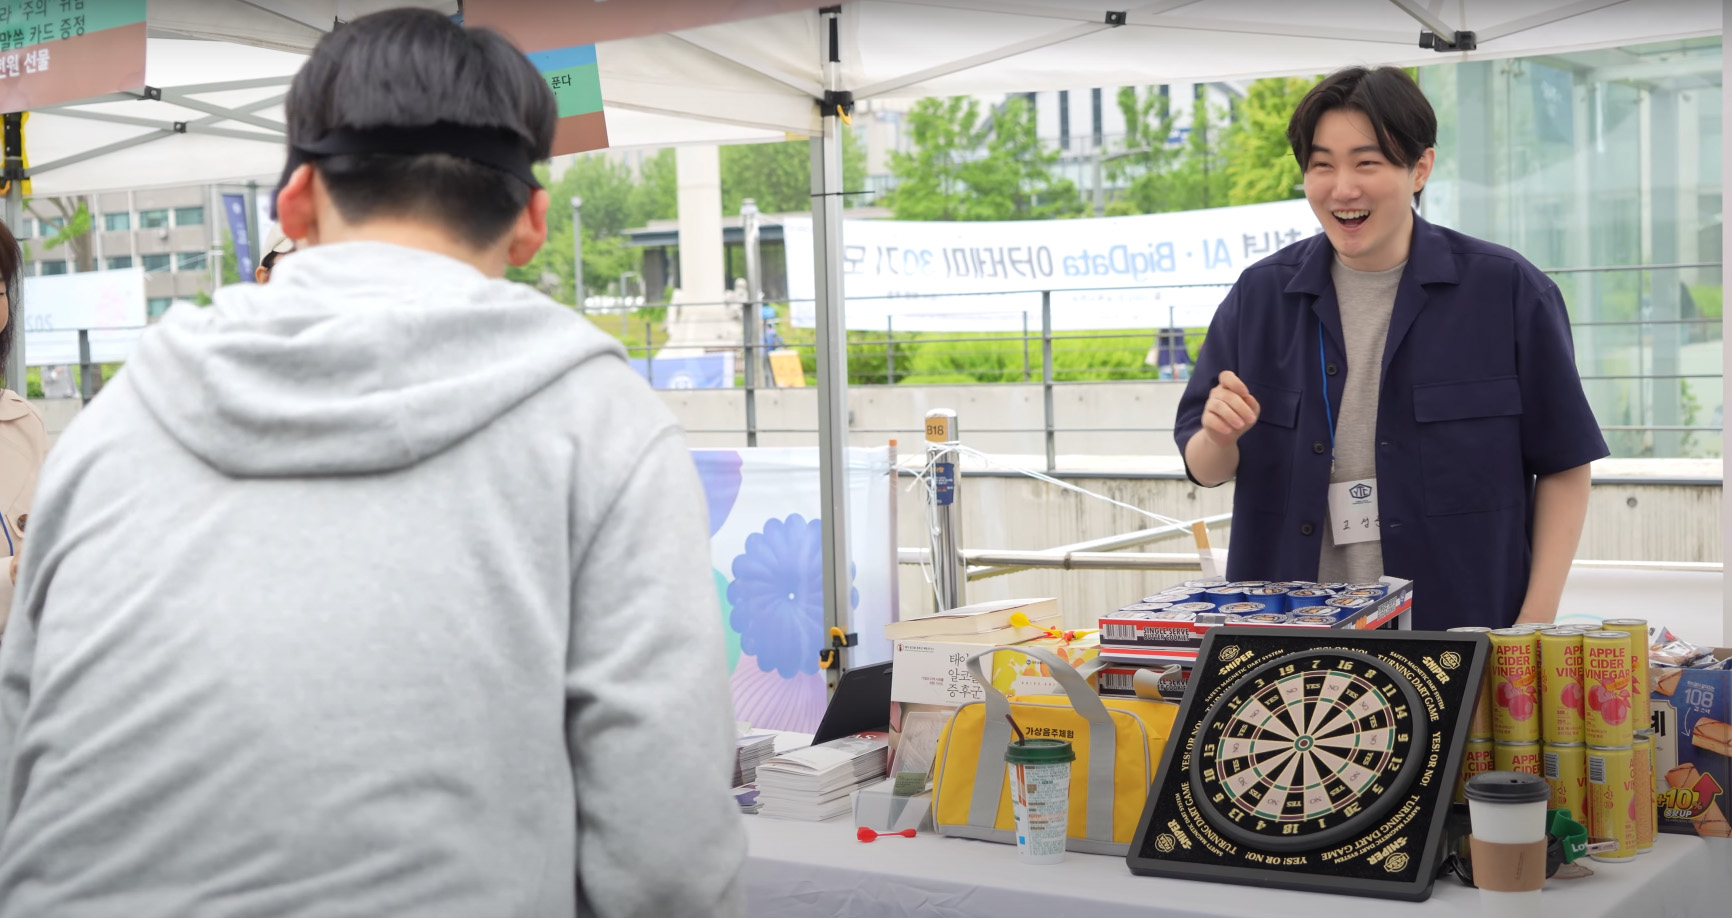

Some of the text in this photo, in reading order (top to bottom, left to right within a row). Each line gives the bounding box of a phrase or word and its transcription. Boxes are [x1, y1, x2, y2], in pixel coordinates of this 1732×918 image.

[0, 15, 85, 52] 말씀 카드 증정
[24, 48, 50, 74] 선물
[1143, 627, 1189, 636] SINGLE SERVE
[1496, 645, 1530, 655] APPLE
[1590, 648, 1625, 657] APPLE
[1218, 651, 1254, 676] SNIPER
[1312, 660, 1321, 669] 7
[1337, 660, 1354, 670] 16
[1497, 656, 1530, 665] CIDER
[1565, 657, 1583, 666] CID
[1590, 659, 1624, 669] CIDER
[1279, 665, 1295, 676] 19
[1364, 669, 1377, 678] 8
[1422, 656, 1450, 685] SNIPER
[1492, 666, 1536, 677] VINEGAR
[1556, 667, 1584, 677] VINE
[1585, 669, 1630, 679] VINEGAR
[1255, 679, 1265, 688] 3
[947, 684, 982, 699] 증후군
[1382, 683, 1397, 697] 11
[1228, 696, 1242, 710] 17
[1411, 678, 1430, 697] DART
[1425, 697, 1440, 722] GAME
[1685, 688, 1714, 708] 108
[1395, 705, 1408, 719] 14
[1213, 722, 1224, 730] 2
[1026, 727, 1074, 739] 가상음주체험
[1398, 734, 1409, 742] 9
[1204, 744, 1215, 757] 15
[1467, 751, 1495, 761] APPL
[1388, 757, 1403, 771] 12
[1420, 731, 1441, 786] YES! OR NO!
[1468, 761, 1495, 771] CIDE
[1204, 768, 1215, 783] 10
[1372, 784, 1384, 795] 5
[1213, 792, 1224, 803] 6
[1228, 808, 1245, 822] 13
[1343, 802, 1362, 817] 20
[1181, 781, 1237, 855] TURNING DART GAME
[1318, 818, 1326, 829] 1
[1256, 821, 1267, 830] 4
[1282, 824, 1299, 834] 18
[1321, 795, 1420, 861] TURNING DART GAME
[1167, 819, 1192, 849] SNIPER
[1367, 837, 1408, 865] SNIPER
[1245, 852, 1307, 865] YES! OR NO!
